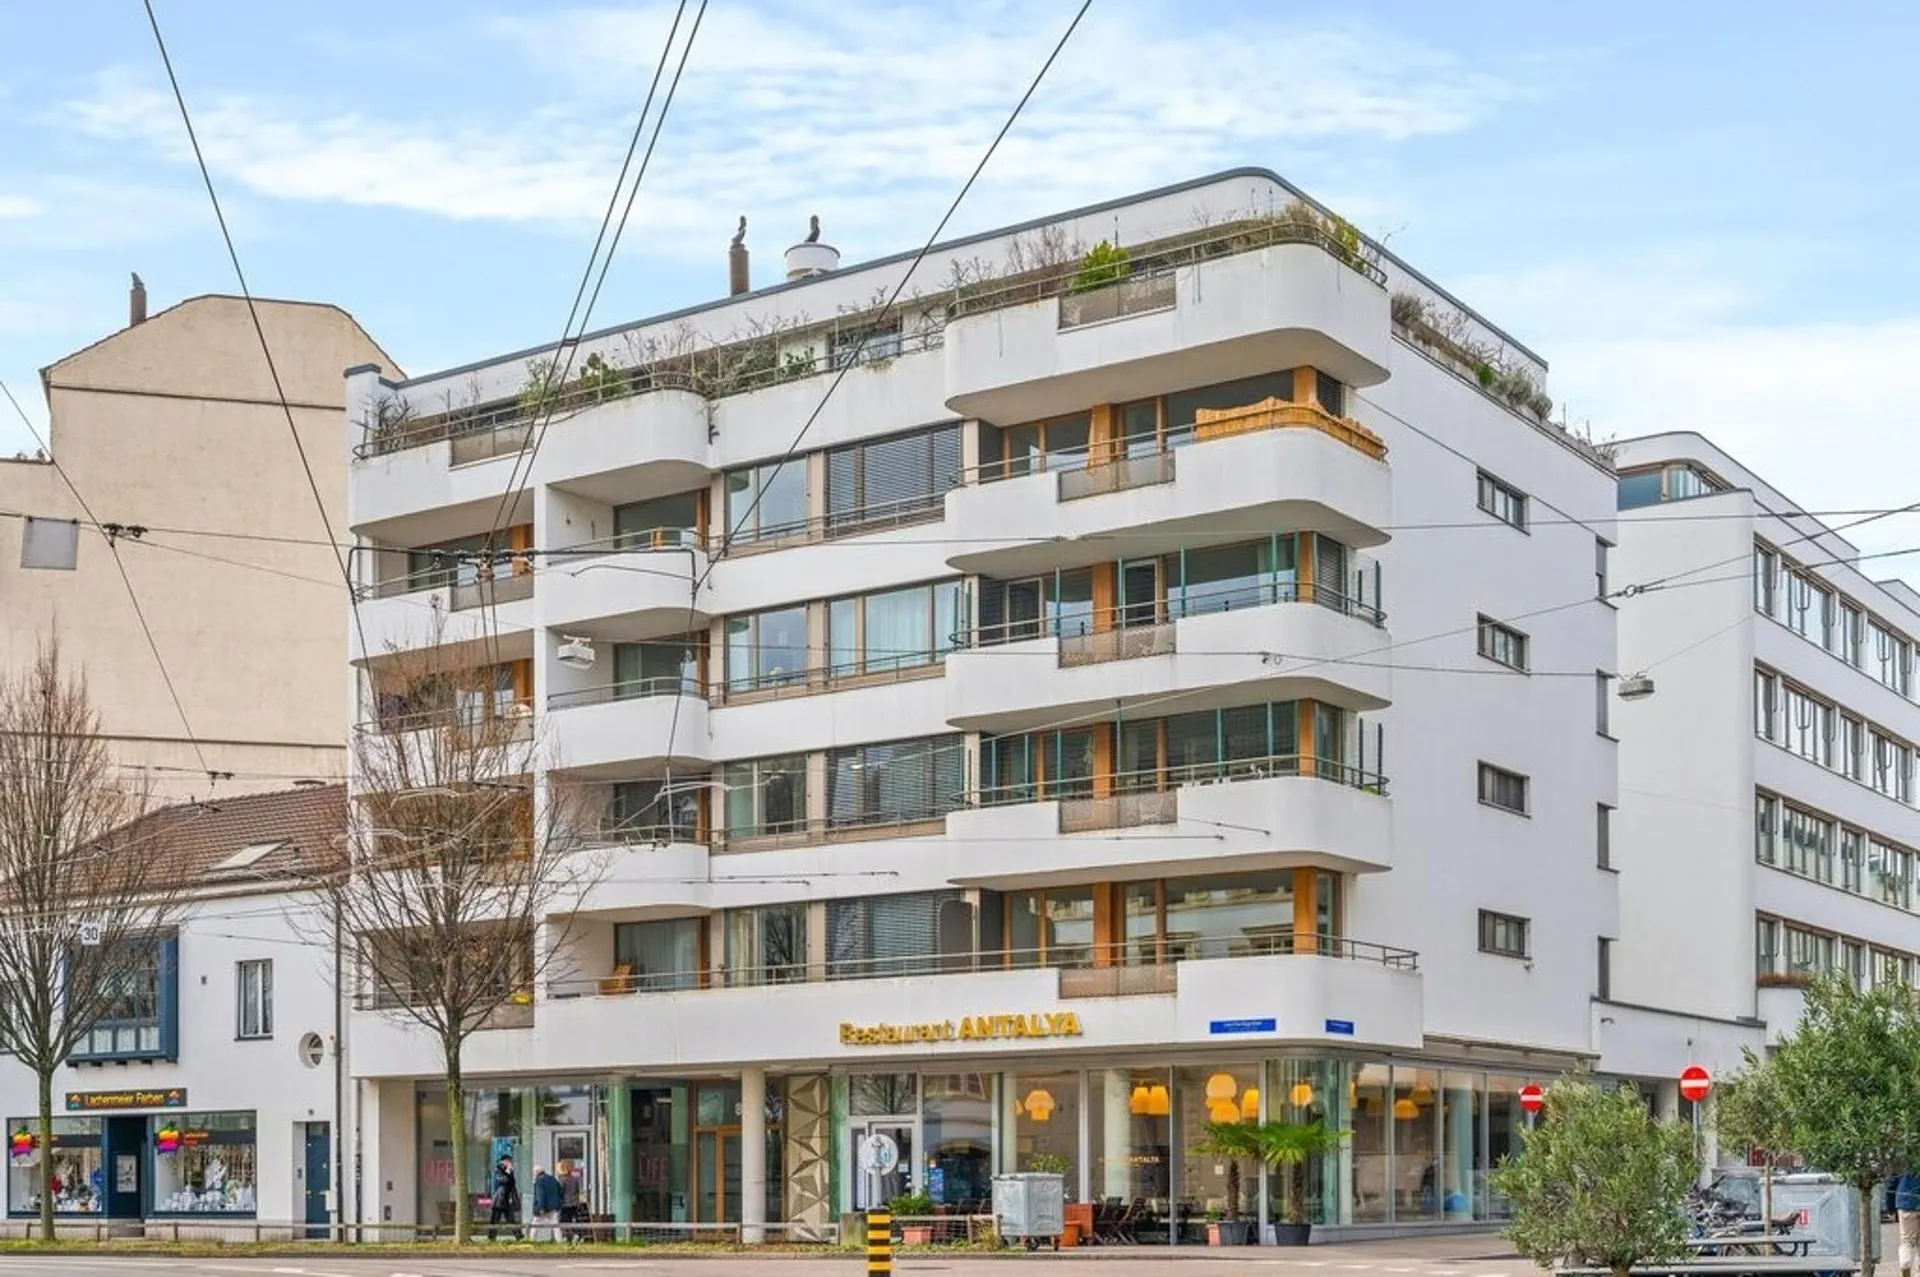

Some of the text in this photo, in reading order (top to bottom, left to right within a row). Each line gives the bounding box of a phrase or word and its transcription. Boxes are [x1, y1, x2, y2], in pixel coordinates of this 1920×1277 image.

[84, 927, 98, 940] 30
[840, 1012, 1081, 1043] Restaurant ANTALYA
